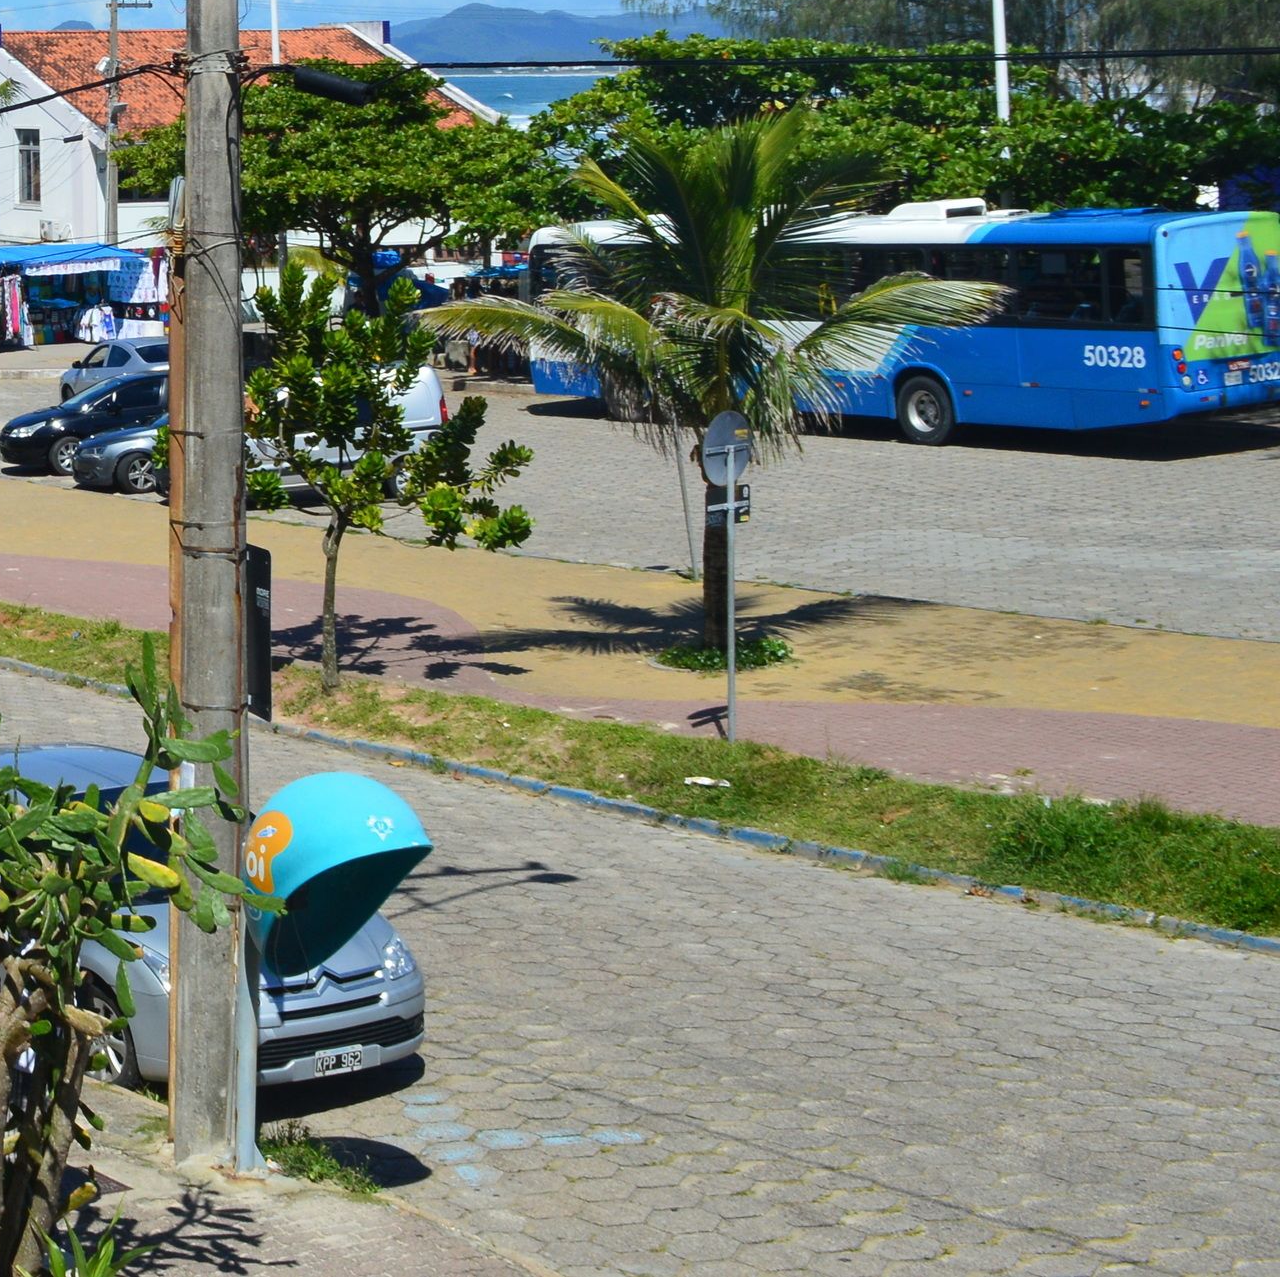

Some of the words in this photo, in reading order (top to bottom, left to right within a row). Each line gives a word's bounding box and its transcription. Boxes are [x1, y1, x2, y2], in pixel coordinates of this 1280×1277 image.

[1083, 345, 1147, 369] 50328
[316, 1056, 337, 1072] KPP
[341, 1051, 362, 1068] 962
